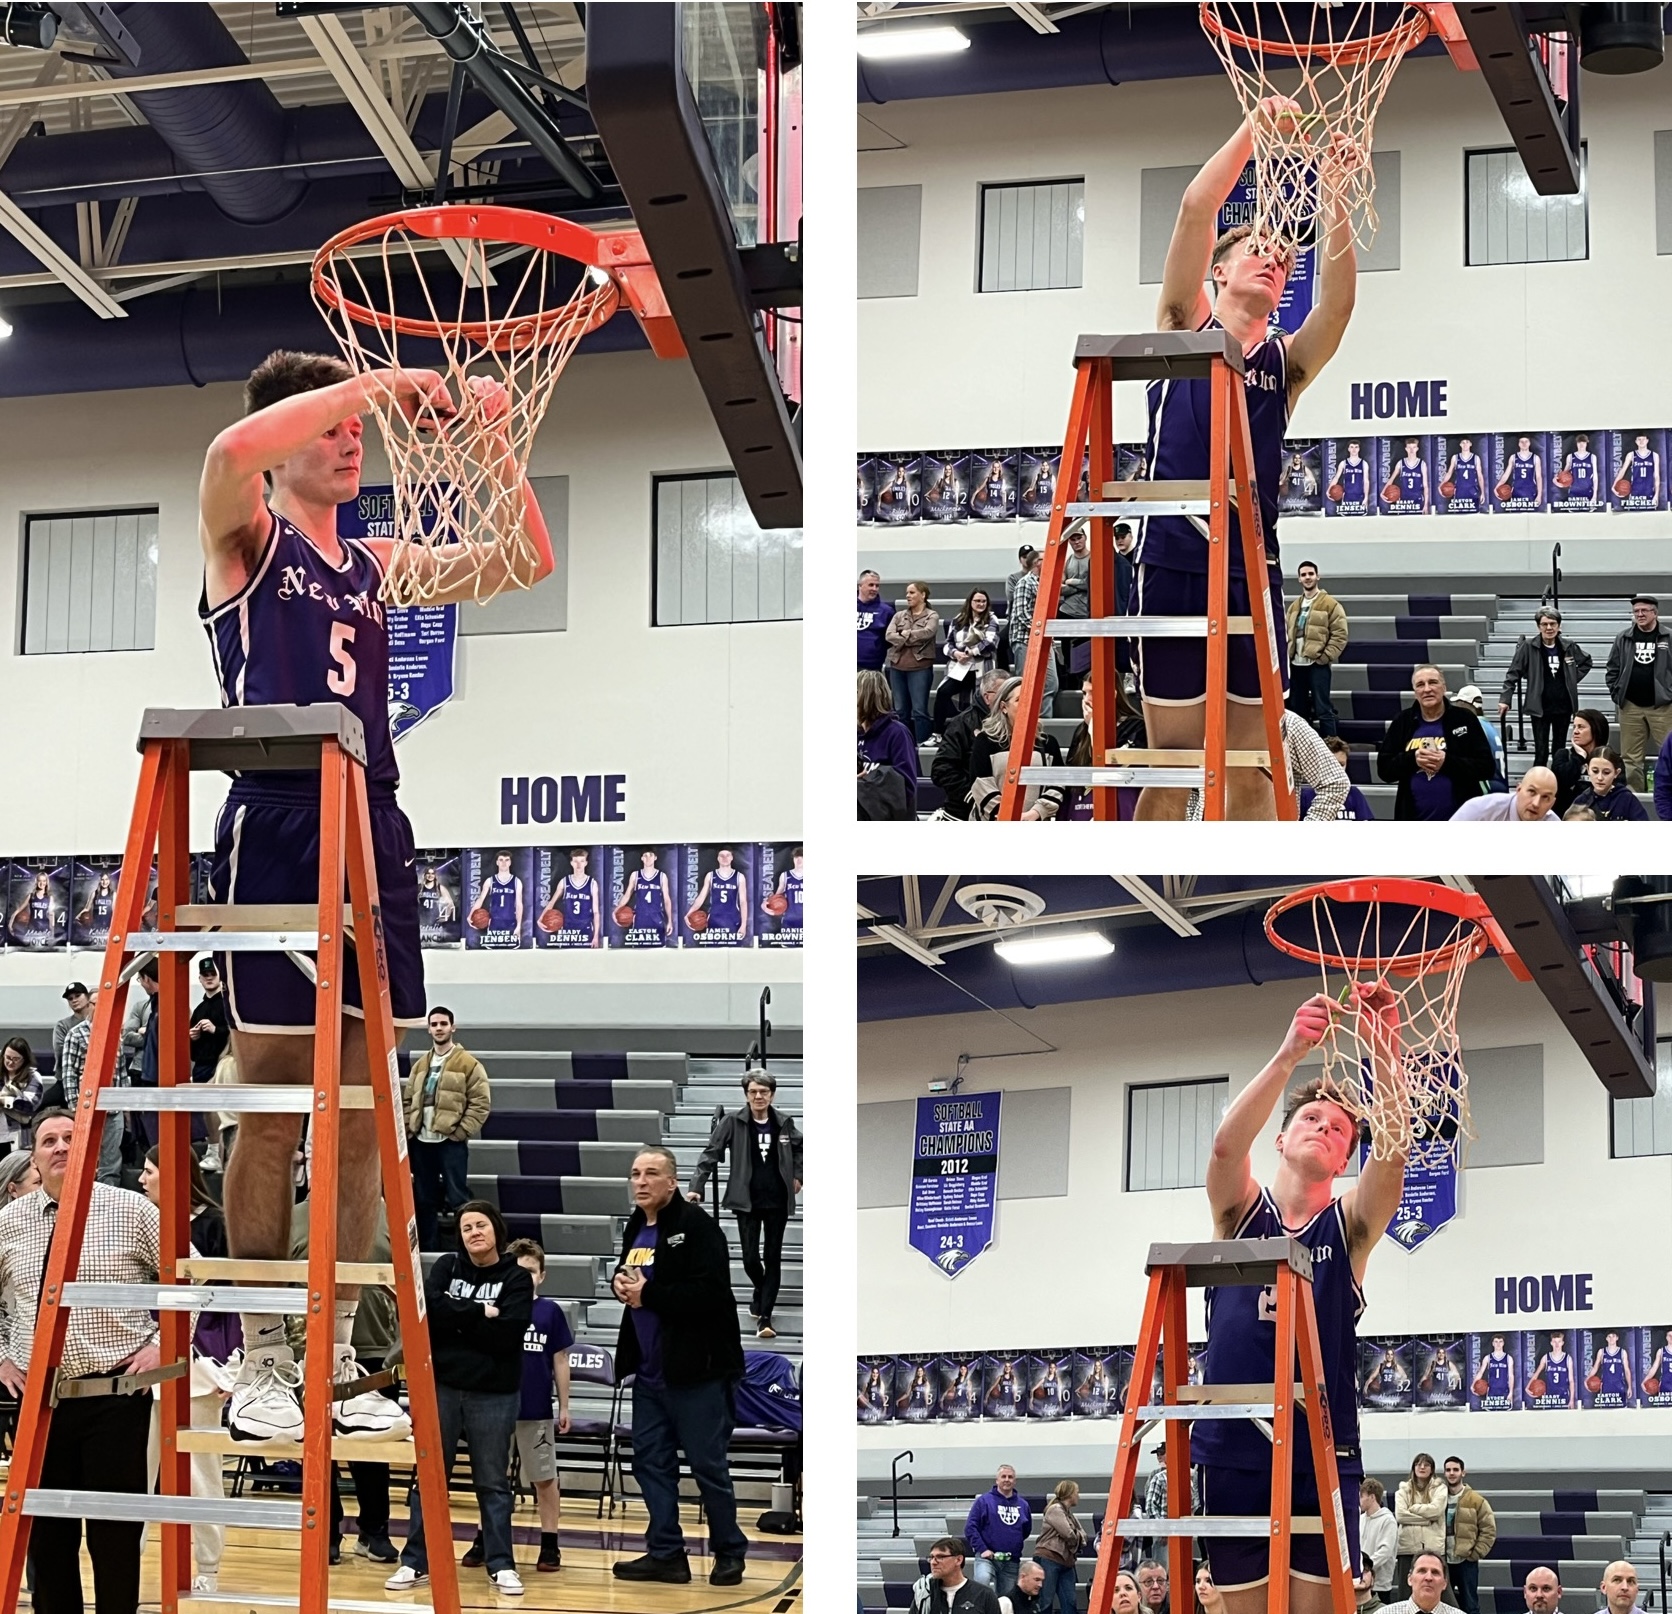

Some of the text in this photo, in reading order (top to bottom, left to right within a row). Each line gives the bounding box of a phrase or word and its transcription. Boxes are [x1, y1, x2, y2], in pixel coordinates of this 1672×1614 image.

[1268, 311, 1280, 324] -3
[1351, 380, 1447, 420] HOME
[1351, 474, 1355, 484] 1
[1463, 470, 1469, 479] 4
[1521, 469, 1527, 479] 5
[1578, 469, 1586, 478] 10
[1408, 479, 1414, 488] 3
[990, 489, 997, 497] 14
[327, 621, 356, 697] 5
[388, 682, 409, 700] 5-3
[501, 775, 626, 824] HOME
[500, 895, 504, 907] 1
[645, 891, 652, 903] 4
[720, 891, 727, 903] 5
[424, 899, 433, 908] 41
[573, 901, 580, 914] 3
[99, 906, 107, 915] 15
[480, 935, 518, 943] JENSEN
[934, 1101, 983, 1122] SOFTBALL
[939, 1120, 974, 1133] STATE AA
[919, 1130, 993, 1156] CHAMPIONS
[941, 1159, 969, 1175] 2012
[1397, 1206, 1422, 1220] 25-3
[940, 1235, 963, 1248] 24-3
[625, 1248, 655, 1266] KING
[1495, 1274, 1593, 1314] HOME
[569, 1353, 604, 1369] GLES
[1496, 1368, 1499, 1378] 1
[1610, 1364, 1615, 1373] 4
[1383, 1374, 1392, 1382] 32
[1436, 1373, 1444, 1381] 41
[1553, 1373, 1559, 1383] 3
[1047, 1387, 1054, 1396] 10
[1092, 1387, 1100, 1395] 12
[1396, 1380, 1410, 1392] 32
